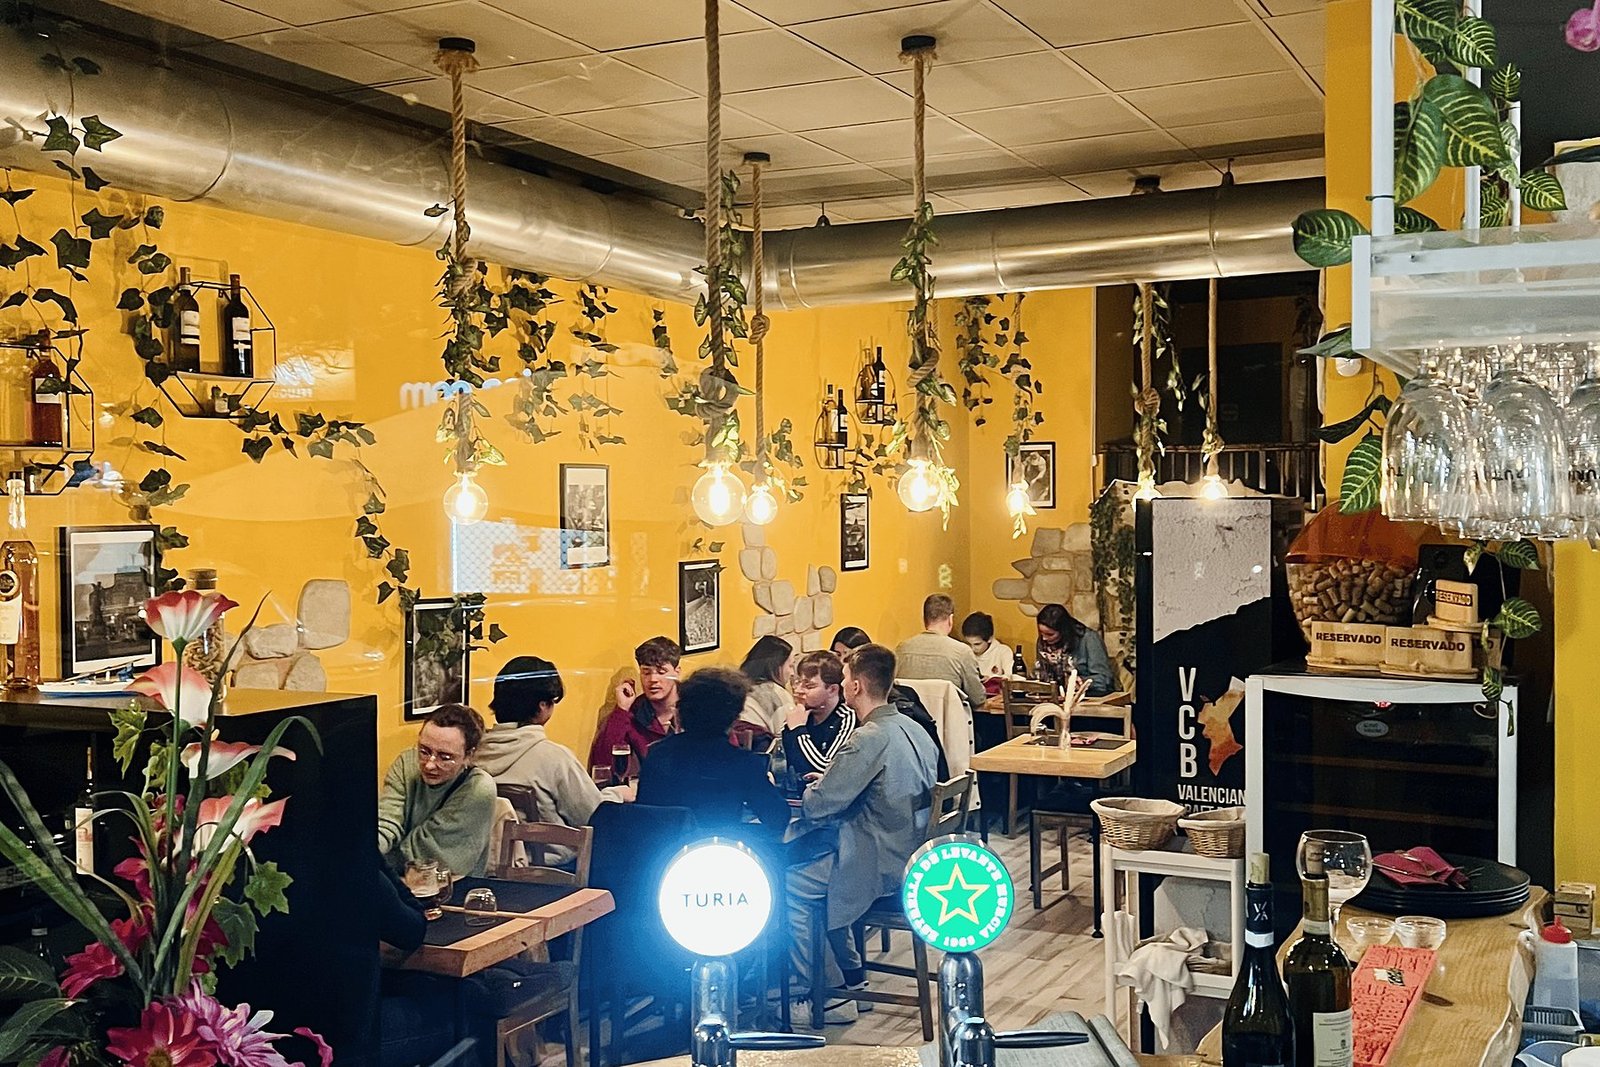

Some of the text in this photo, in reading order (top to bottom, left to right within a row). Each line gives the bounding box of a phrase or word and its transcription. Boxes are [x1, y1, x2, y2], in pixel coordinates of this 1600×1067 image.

[1316, 632, 1382, 644] RESERVADO
[1391, 638, 1466, 652] RESERVADO
[1177, 784, 1246, 805] VALENCIAN
[680, 892, 749, 907] TURIA
